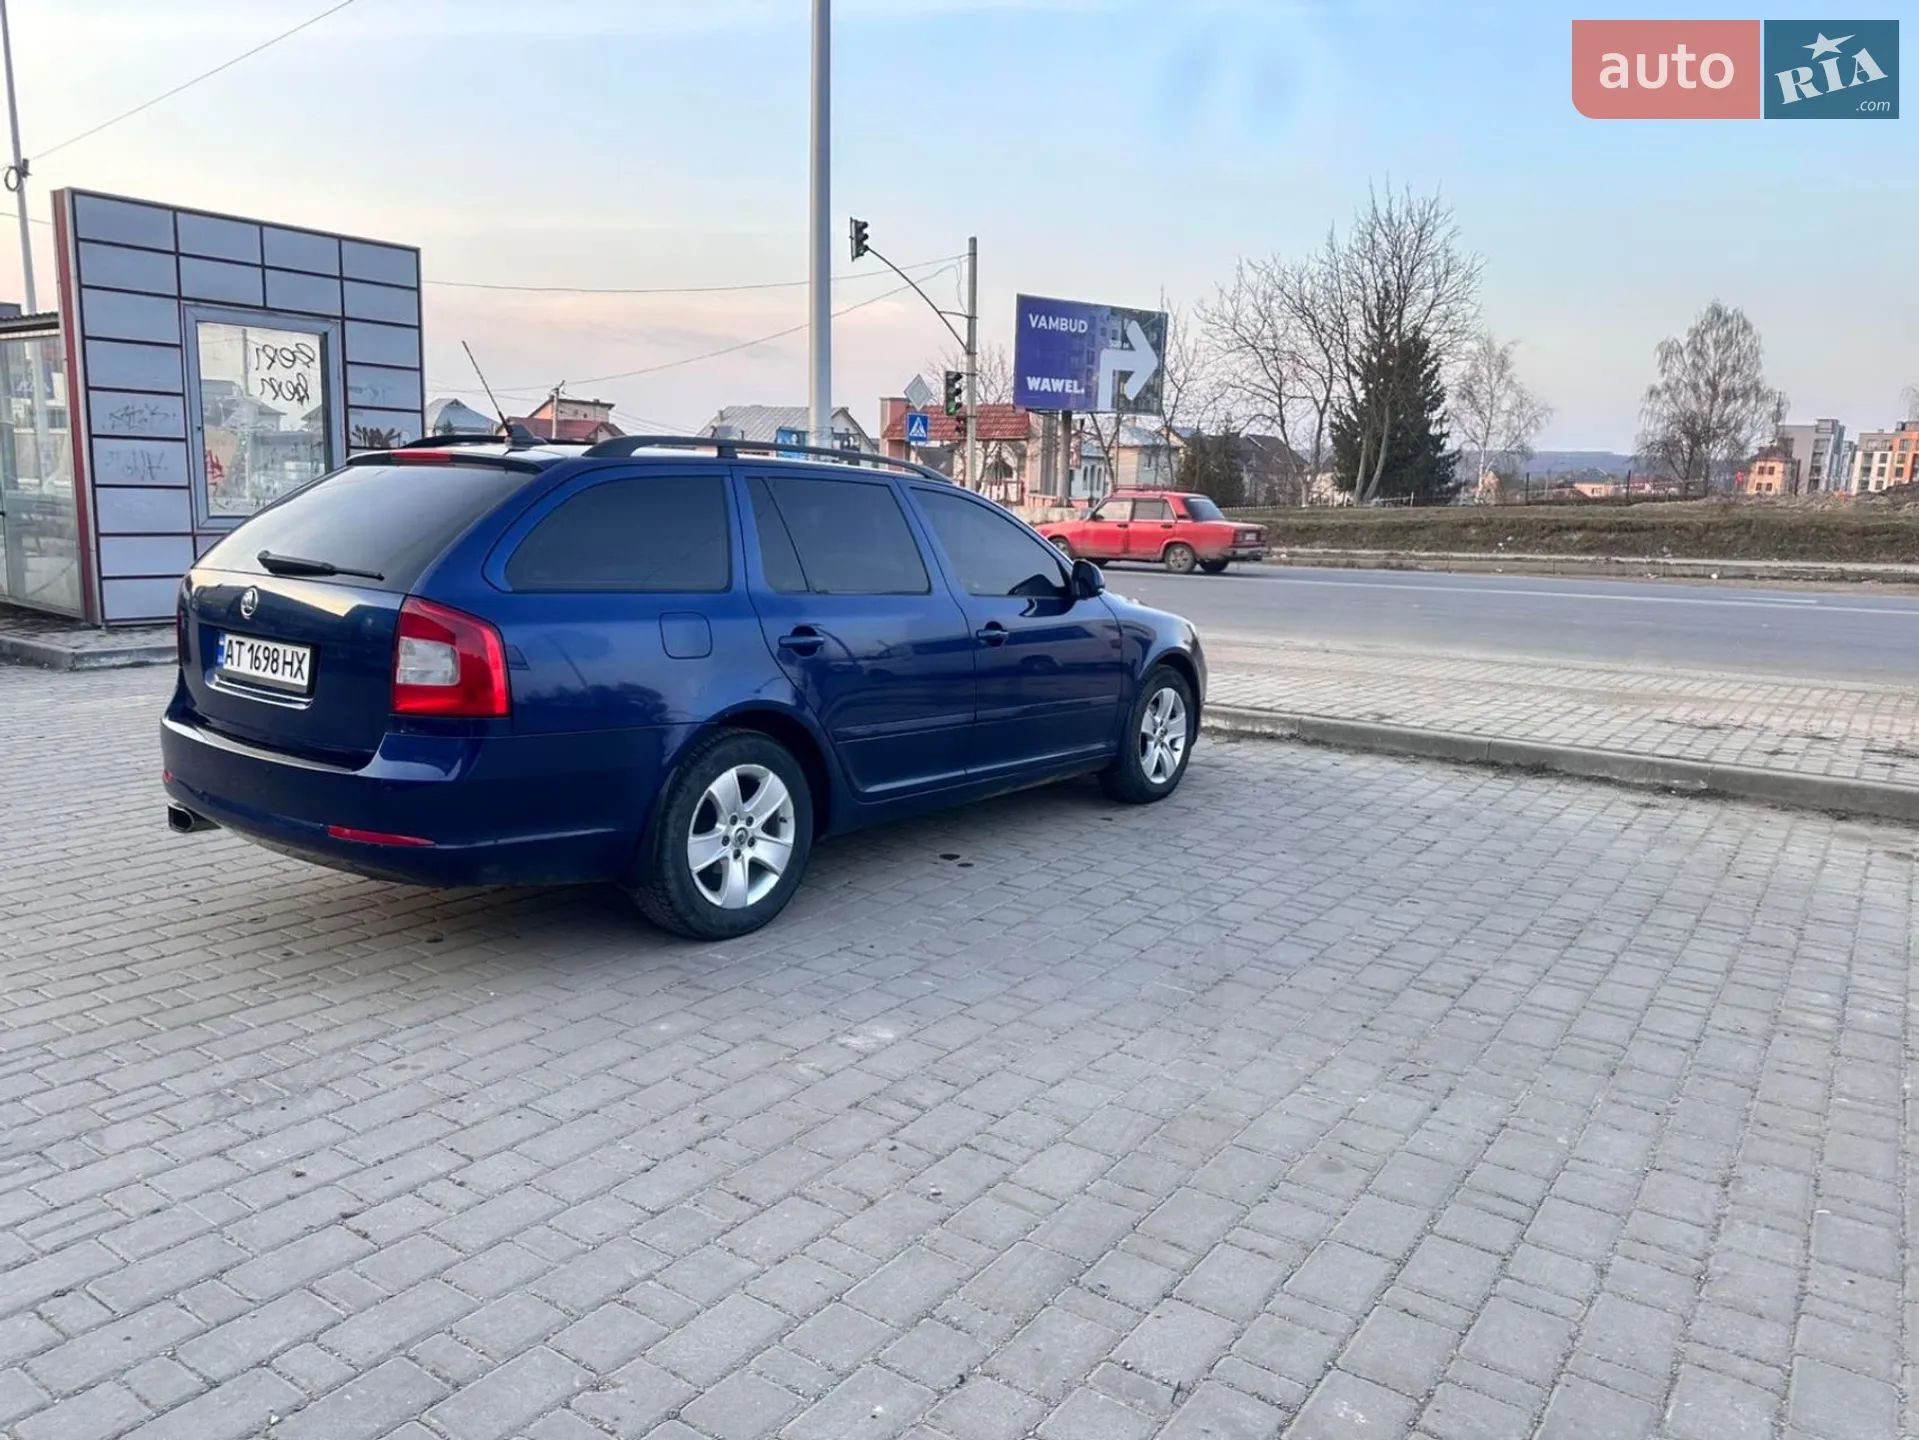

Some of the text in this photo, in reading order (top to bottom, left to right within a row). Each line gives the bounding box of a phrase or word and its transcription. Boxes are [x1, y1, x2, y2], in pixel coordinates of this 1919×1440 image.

[1028, 313, 1089, 333] VAMBUD
[224, 639, 307, 681] AT 1698 HX
